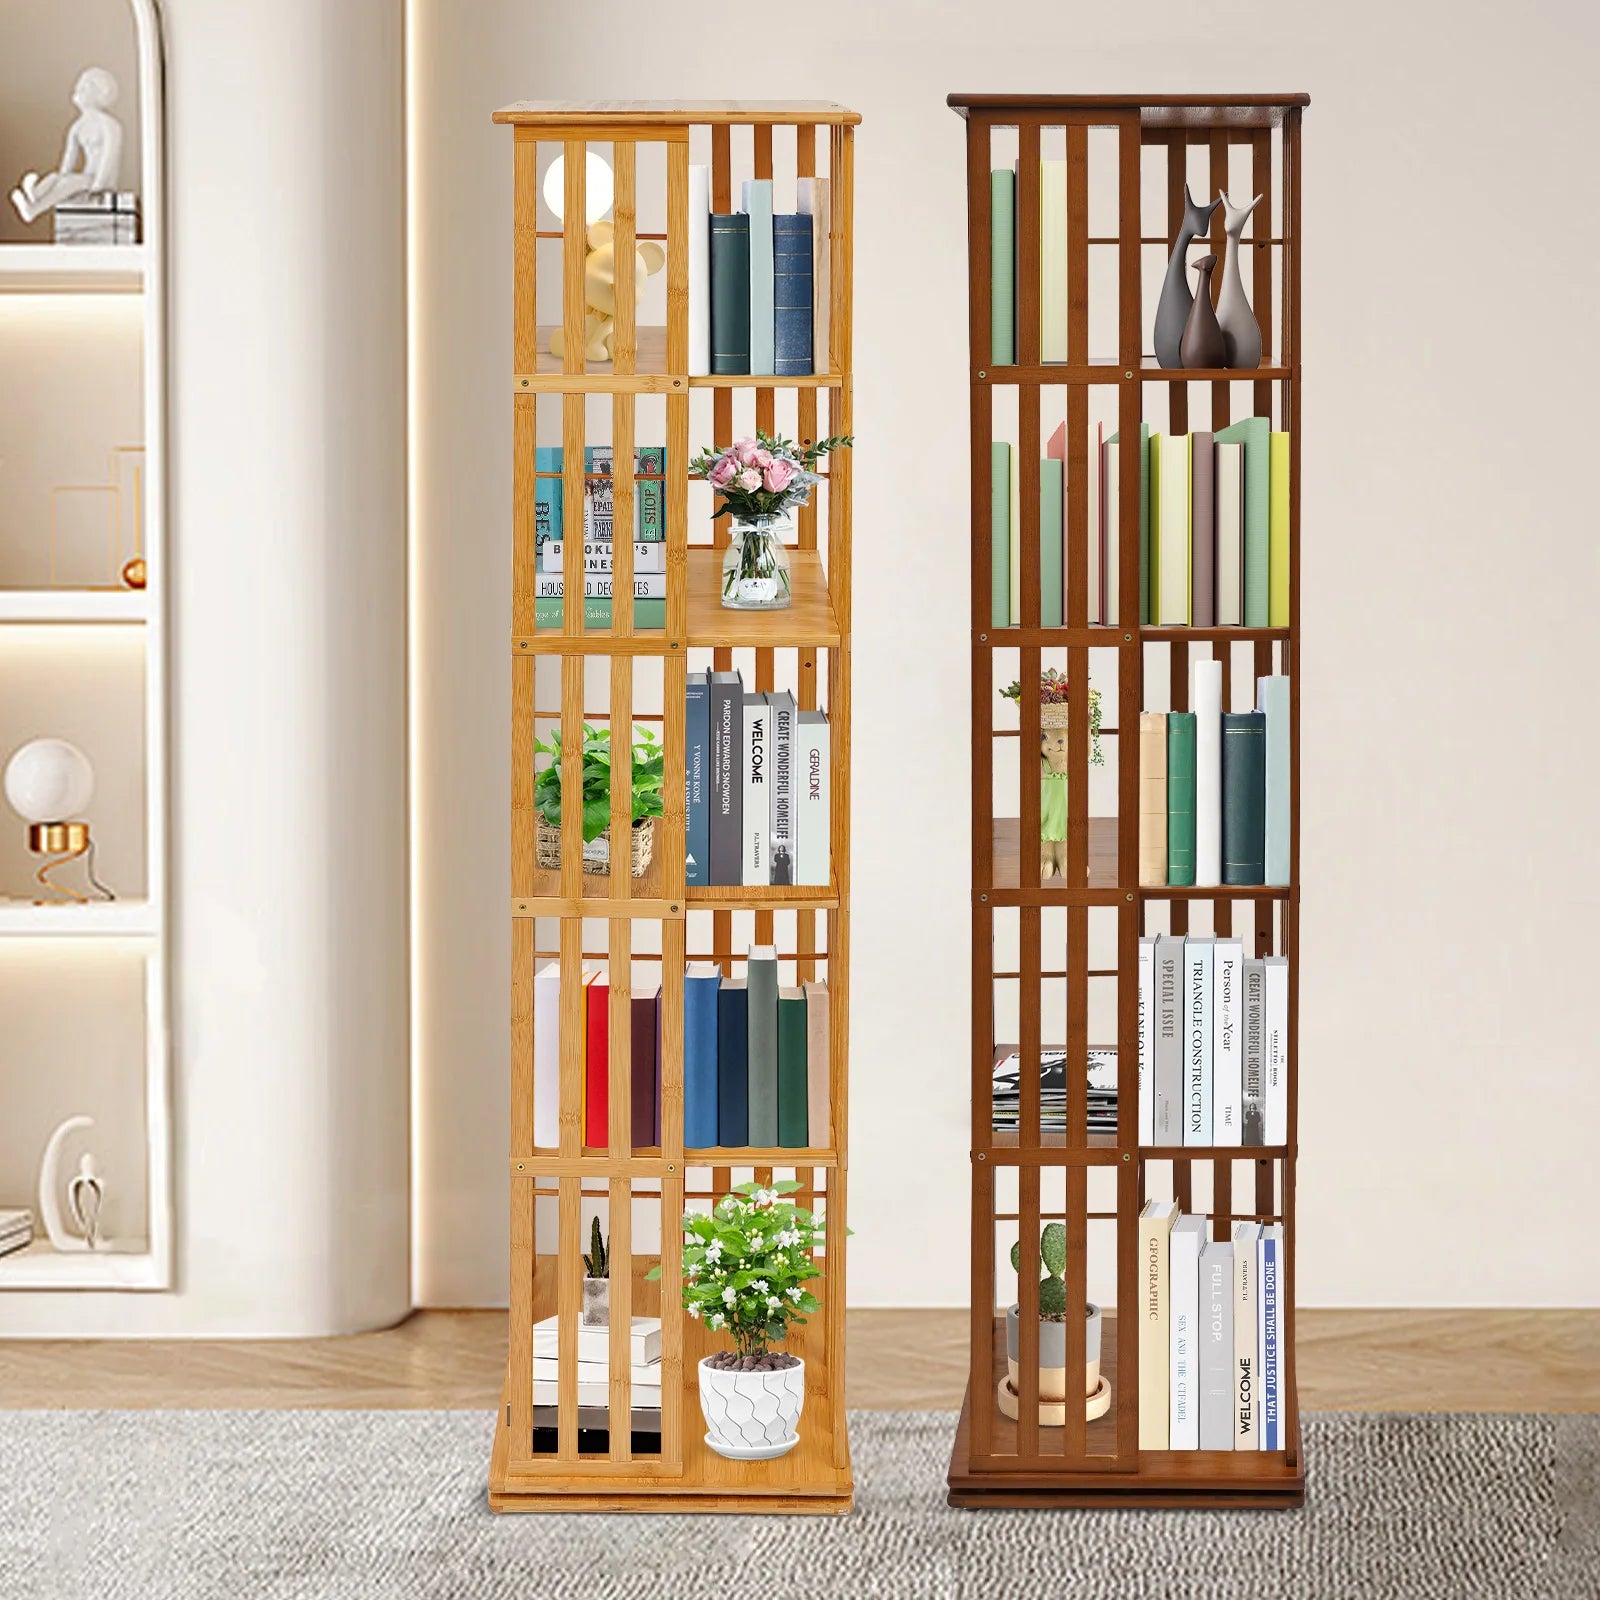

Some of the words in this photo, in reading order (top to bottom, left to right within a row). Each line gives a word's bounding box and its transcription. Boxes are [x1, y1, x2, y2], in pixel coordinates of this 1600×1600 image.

[645, 489, 657, 525] SHOP
[553, 544, 648, 555] BOKL'S
[722, 699, 731, 734] PARDON
[777, 710, 790, 741] CREATE
[722, 735, 731, 771] EDWARD
[752, 719, 763, 784] WELCOME
[777, 744, 789, 798] WONDERFUL
[809, 748, 820, 800] GERALDINE
[722, 772, 731, 814] SNOWDEN
[776, 803, 789, 839] HOMELIFE
[1162, 959, 1174, 1004] SPECIAL
[1193, 960, 1203, 1026] TRIANGLE
[1223, 960, 1233, 1004] Person
[1249, 973, 1260, 1002] CREATE
[1162, 1009, 1174, 1039] ISSUE
[1223, 1024, 1233, 1052] Year
[1248, 1004, 1260, 1055] WONDERFUL
[1192, 1029, 1202, 1133] CONSTRUCTION
[1248, 1057, 1259, 1098] HOMELIFE
[1224, 1105, 1232, 1127] TIME
[1149, 1237, 1158, 1321] GEOGRAPHIC
[1211, 1264, 1222, 1299] FULL
[1266, 1261, 1275, 1288] DONE
[1266, 1291, 1275, 1305] BE
[1178, 1315, 1187, 1332] SEX
[1266, 1308, 1275, 1340] SHALL
[1178, 1338, 1187, 1355] AND
[1178, 1359, 1187, 1377] THE
[1267, 1343, 1276, 1389] JUSTICE
[1240, 1358, 1251, 1435] WELCOME
[1267, 1393, 1276, 1424] THAT
